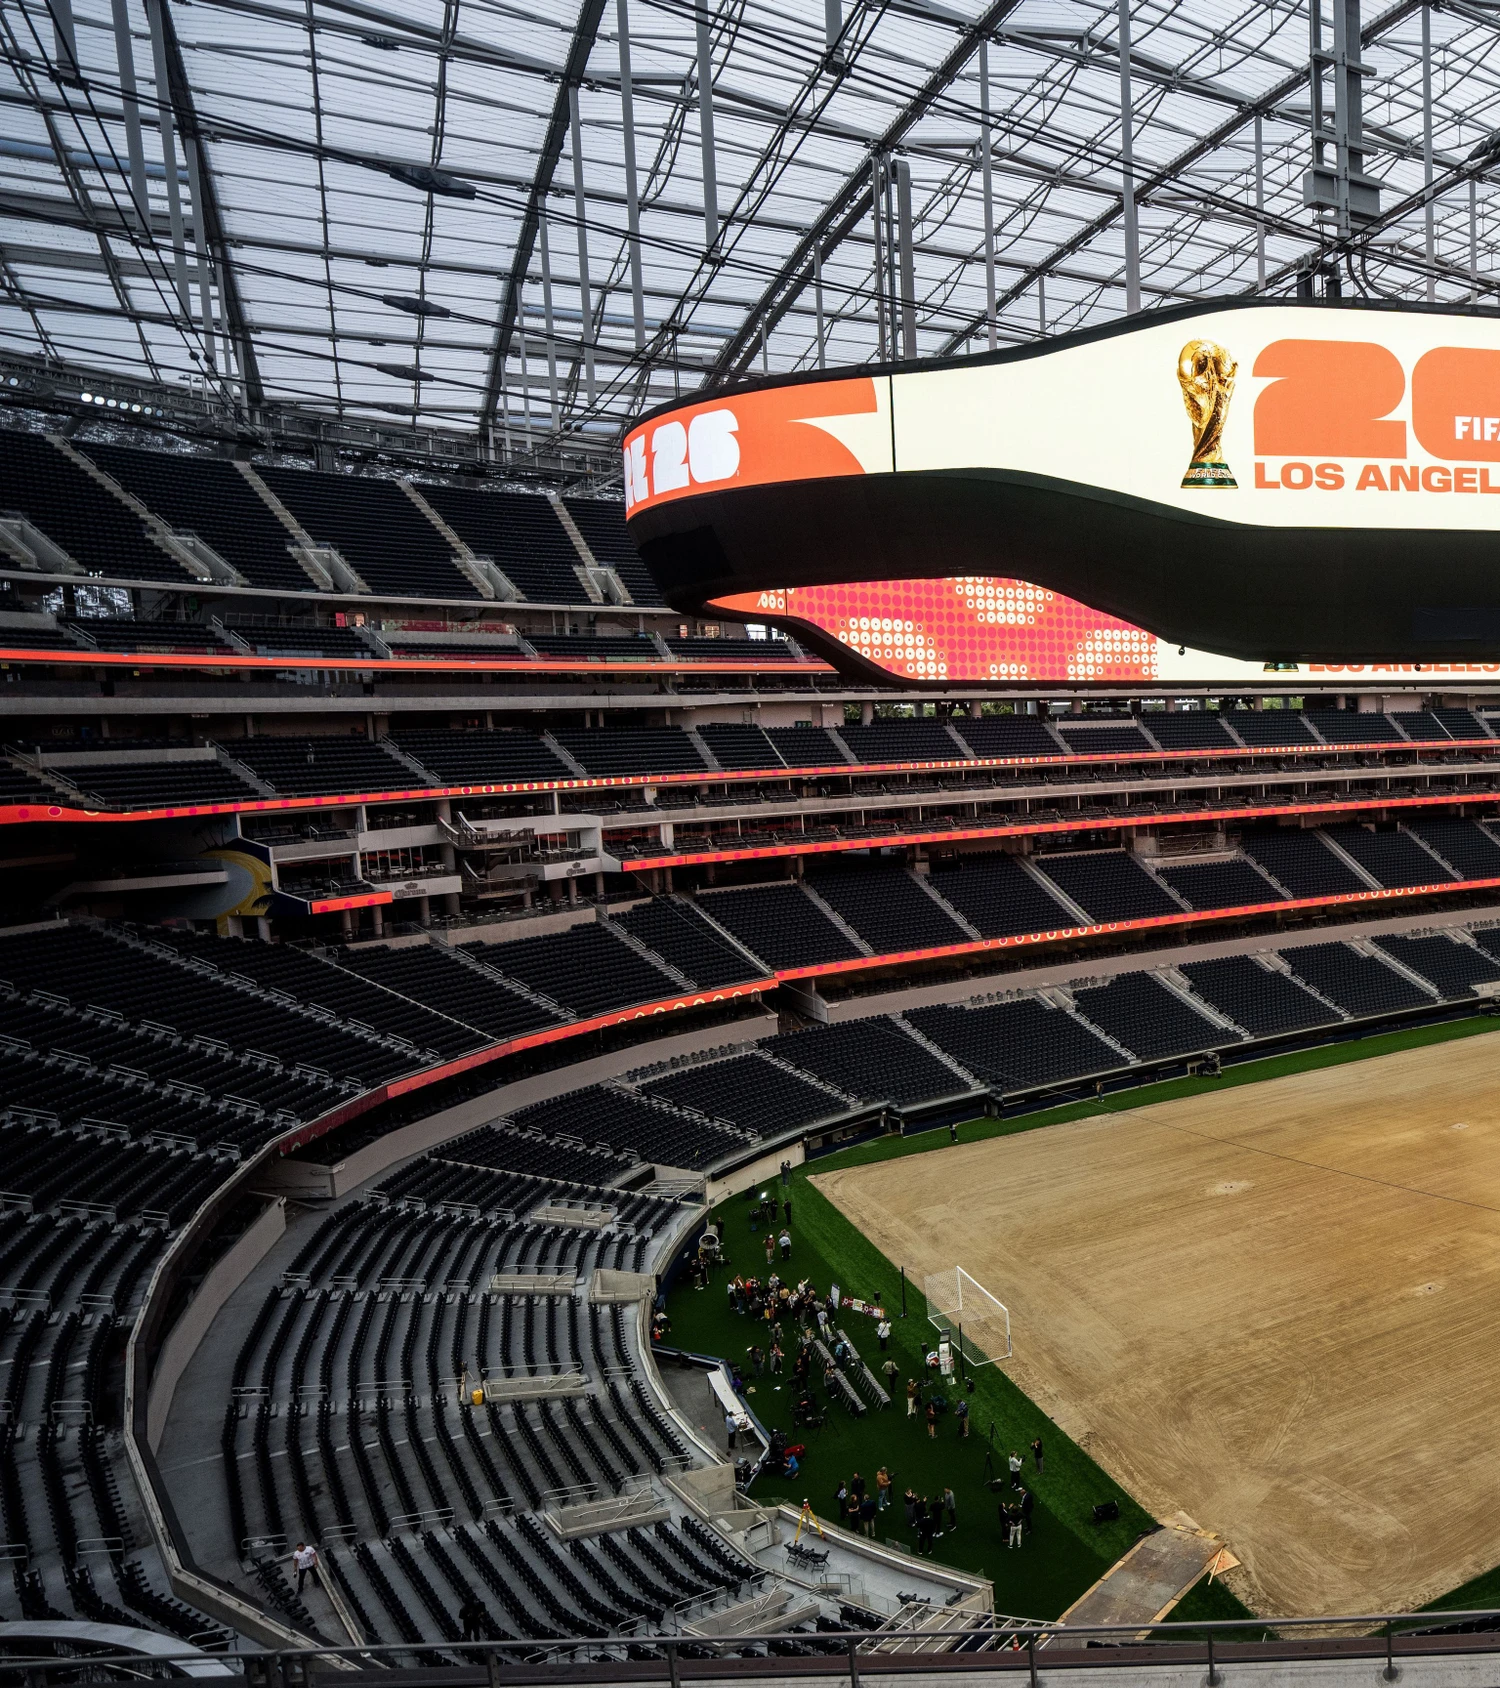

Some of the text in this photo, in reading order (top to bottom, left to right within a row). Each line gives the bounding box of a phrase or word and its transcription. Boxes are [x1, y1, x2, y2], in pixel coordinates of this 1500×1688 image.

[651, 408, 740, 495] 26
[1254, 462, 1345, 490] LOS
[394, 888, 427, 899] Corona
